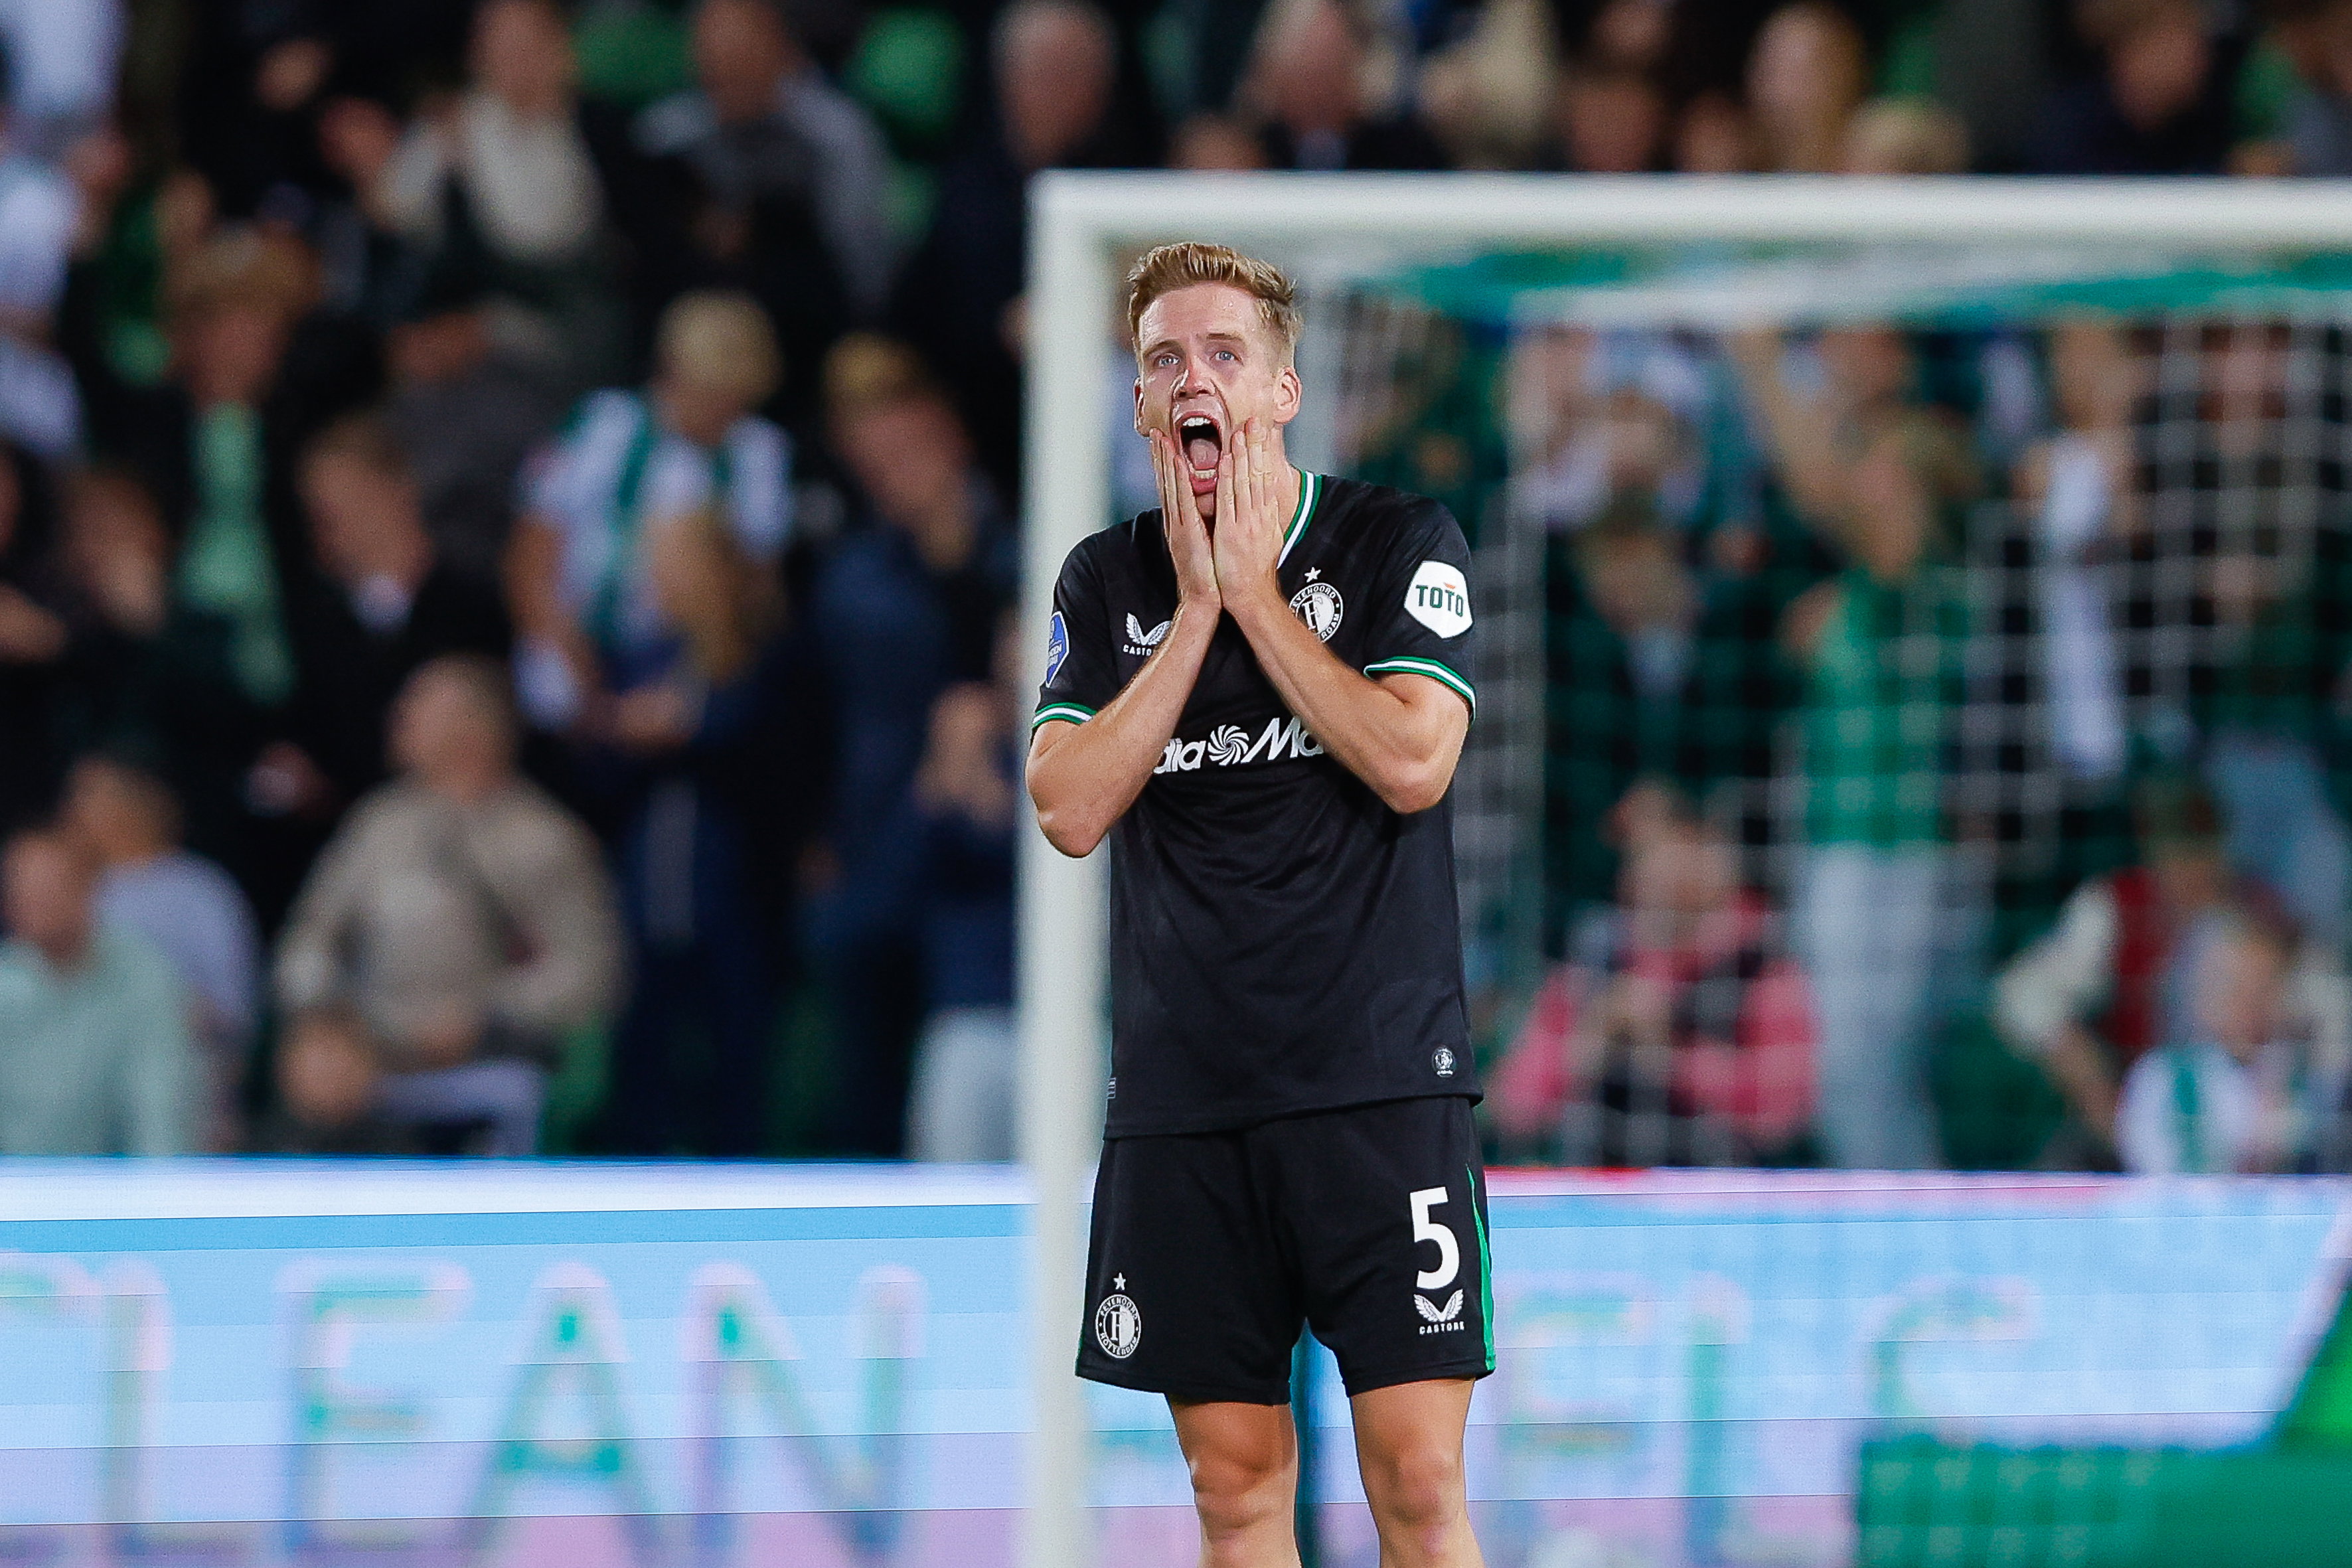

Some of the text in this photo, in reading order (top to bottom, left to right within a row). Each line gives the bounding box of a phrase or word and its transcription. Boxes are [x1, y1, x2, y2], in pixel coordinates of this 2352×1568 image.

[1292, 585, 1336, 609] EYENOORD
[1415, 584, 1464, 617] TOTO
[1123, 644, 1152, 657] CASTO
[1409, 1186, 1460, 1290] 5
[1419, 1320, 1465, 1335] CASTORE
